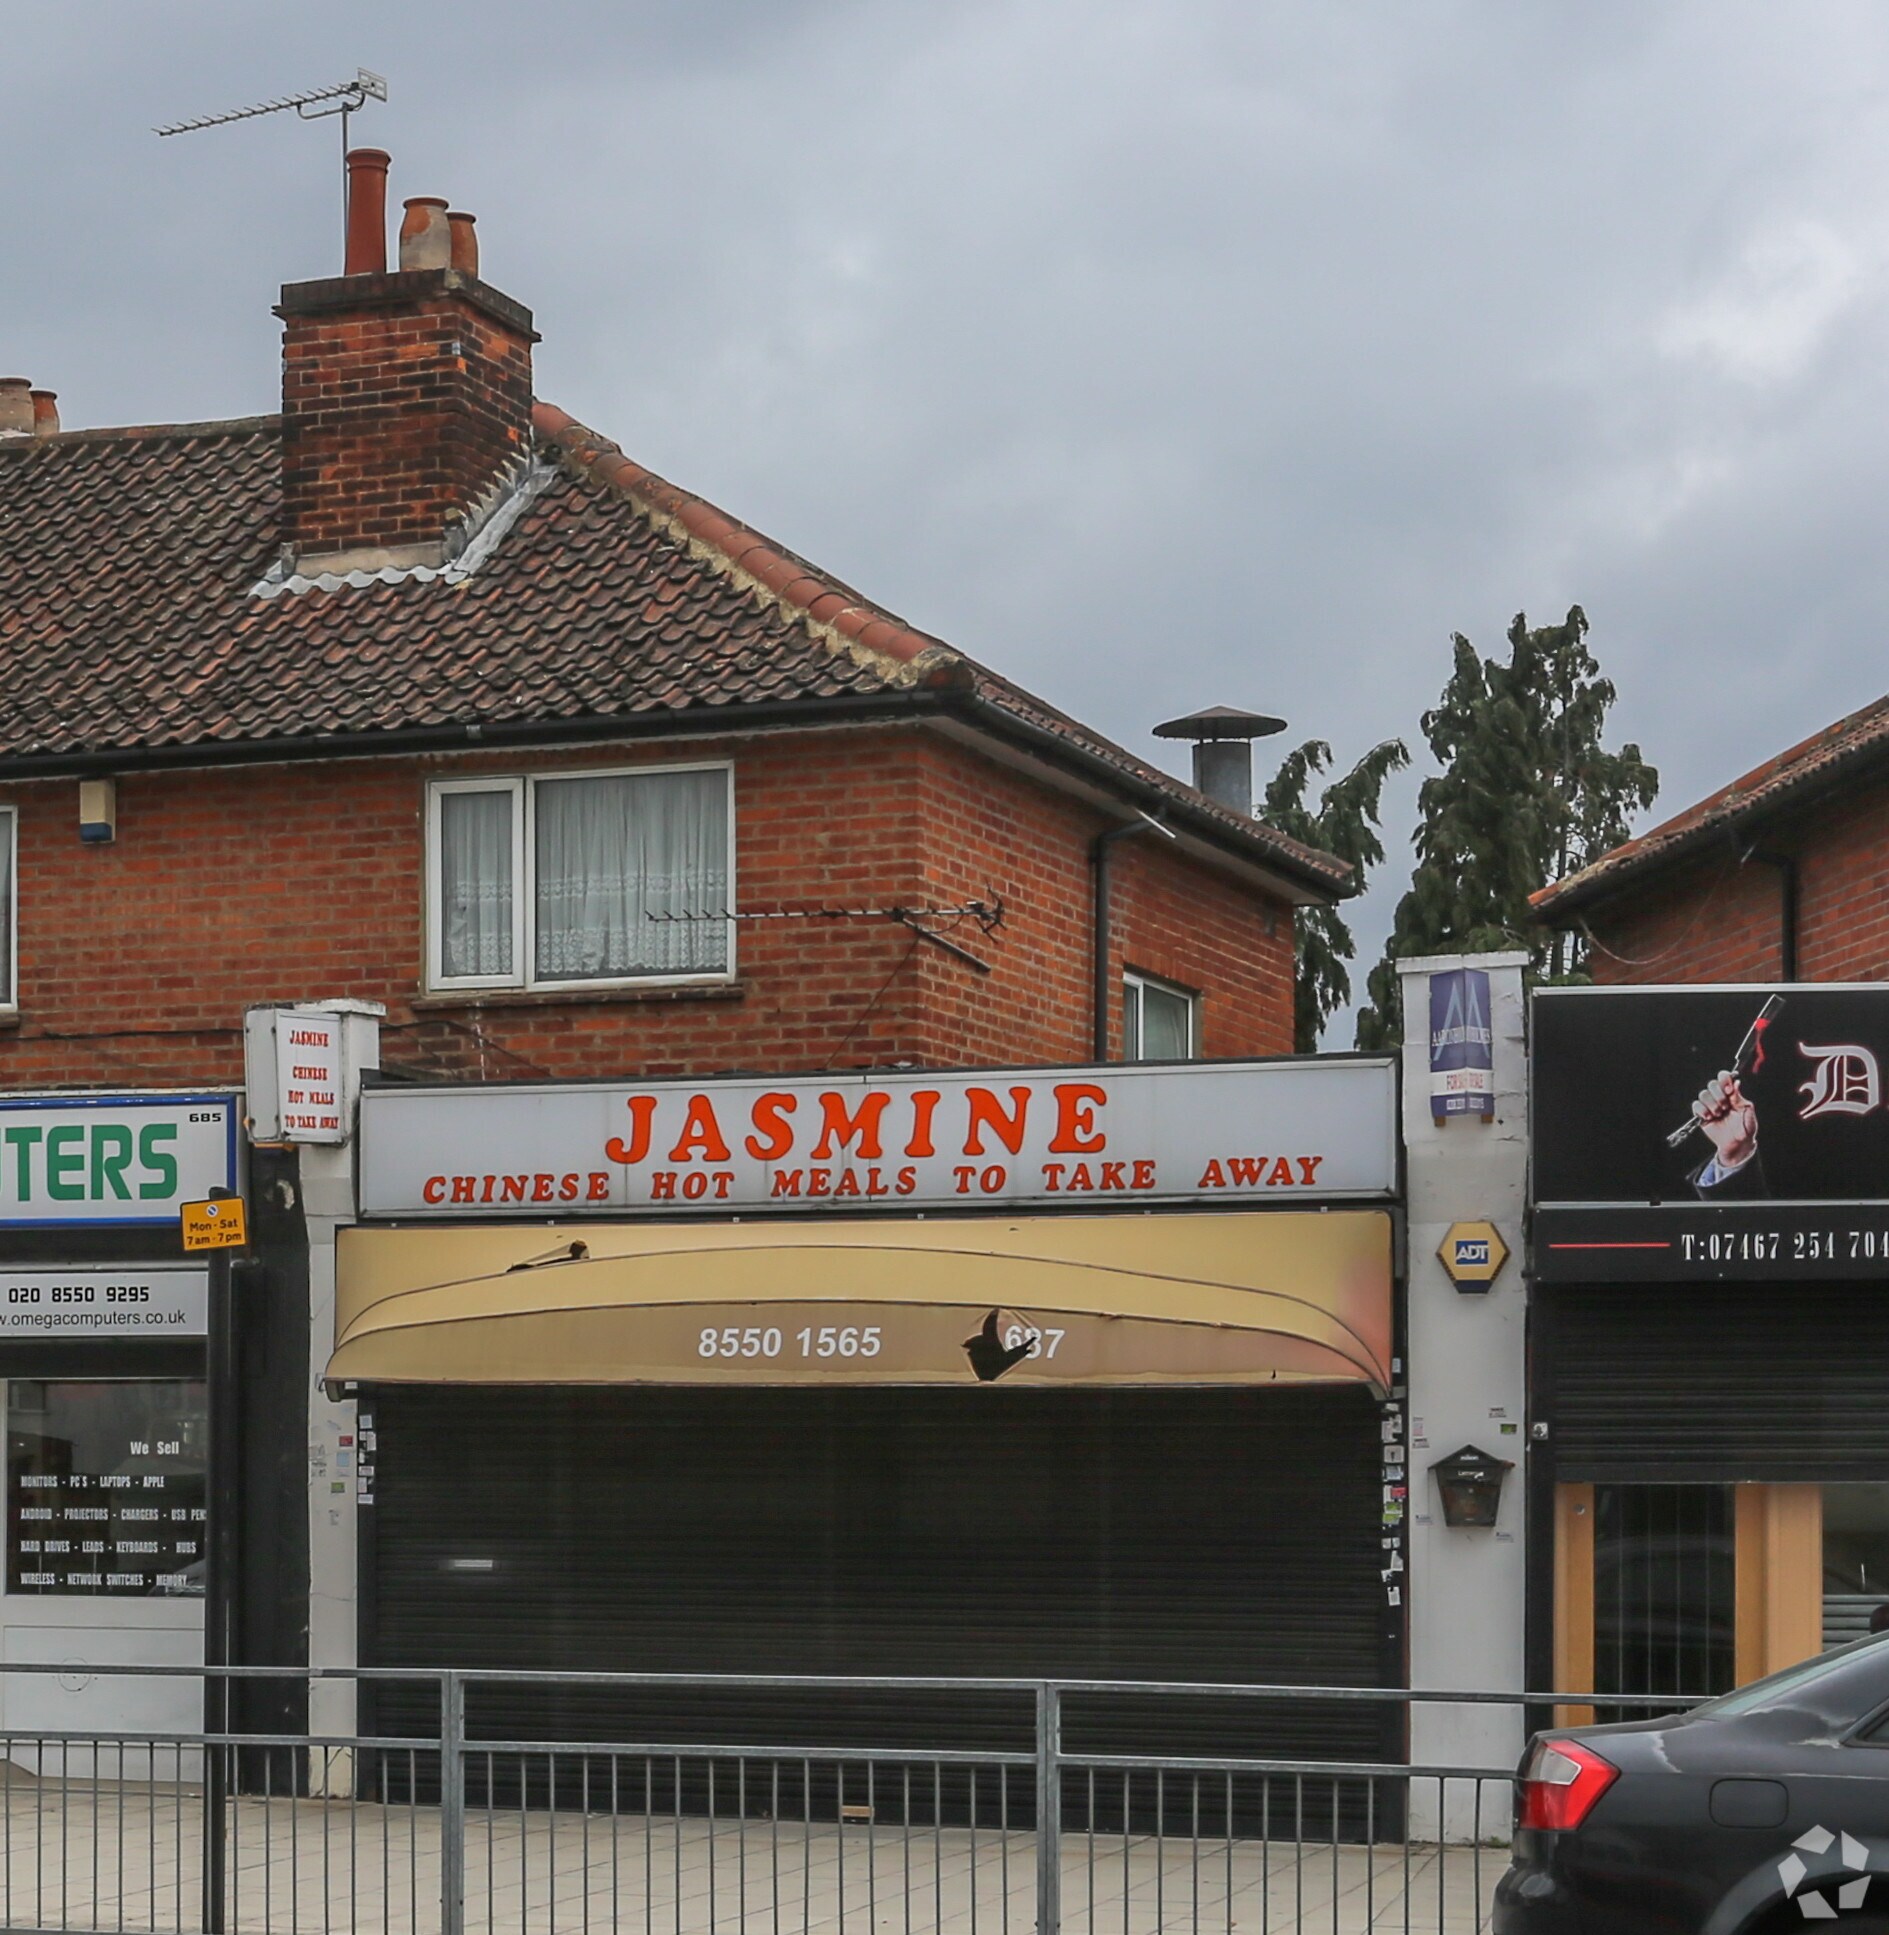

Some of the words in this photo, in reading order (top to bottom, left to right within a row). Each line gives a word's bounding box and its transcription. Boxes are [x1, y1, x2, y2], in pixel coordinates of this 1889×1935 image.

[289, 1029, 329, 1047] JASMINE
[292, 1065, 328, 1081] CHINESE
[288, 1089, 304, 1104] HOT
[309, 1091, 335, 1106] MEALS
[189, 1112, 222, 1123] 685
[285, 1114, 296, 1129] TO
[297, 1115, 316, 1129] TAKE
[319, 1116, 339, 1130] AWAY
[605, 1082, 1108, 1165] JASMINE
[0, 1122, 178, 1202] TERS
[422, 1171, 611, 1205] CHINESE
[650, 1171, 735, 1201] HOT
[770, 1165, 918, 1198] MEALS
[953, 1164, 1007, 1195] TO
[1042, 1159, 1157, 1193] TAKE
[1197, 1156, 1324, 1189] AWAY
[190, 1221, 213, 1233] Mon
[220, 1218, 238, 1229] Sat
[187, 1235, 210, 1246] 7am
[218, 1232, 242, 1244] 7pm
[1681, 1232, 1780, 1261] T:07467
[1793, 1231, 1836, 1260] 254
[1849, 1230, 1889, 1259] 704
[1455, 1244, 1489, 1260] ADT
[9, 1288, 40, 1303] 020
[52, 1287, 94, 1302] 8550
[106, 1286, 150, 1302] 9295
[698, 1327, 782, 1359] 8550
[795, 1326, 881, 1358] 1565
[130, 1441, 149, 1455] We
[157, 1441, 179, 1455] Sell
[20, 1475, 58, 1488] MONITORS
[100, 1476, 131, 1488] LAPTOPS
[143, 1476, 165, 1488] APPLE
[64, 1508, 108, 1521] PROJECTORS
[121, 1508, 159, 1521] CHARGERS
[44, 1540, 70, 1553] DRIVES
[82, 1541, 104, 1553] LEADS
[20, 1573, 55, 1585] WIRELESS
[67, 1573, 102, 1586] NETWORK
[106, 1574, 144, 1587] SWITCHES
[156, 1574, 187, 1587] MEMORY
